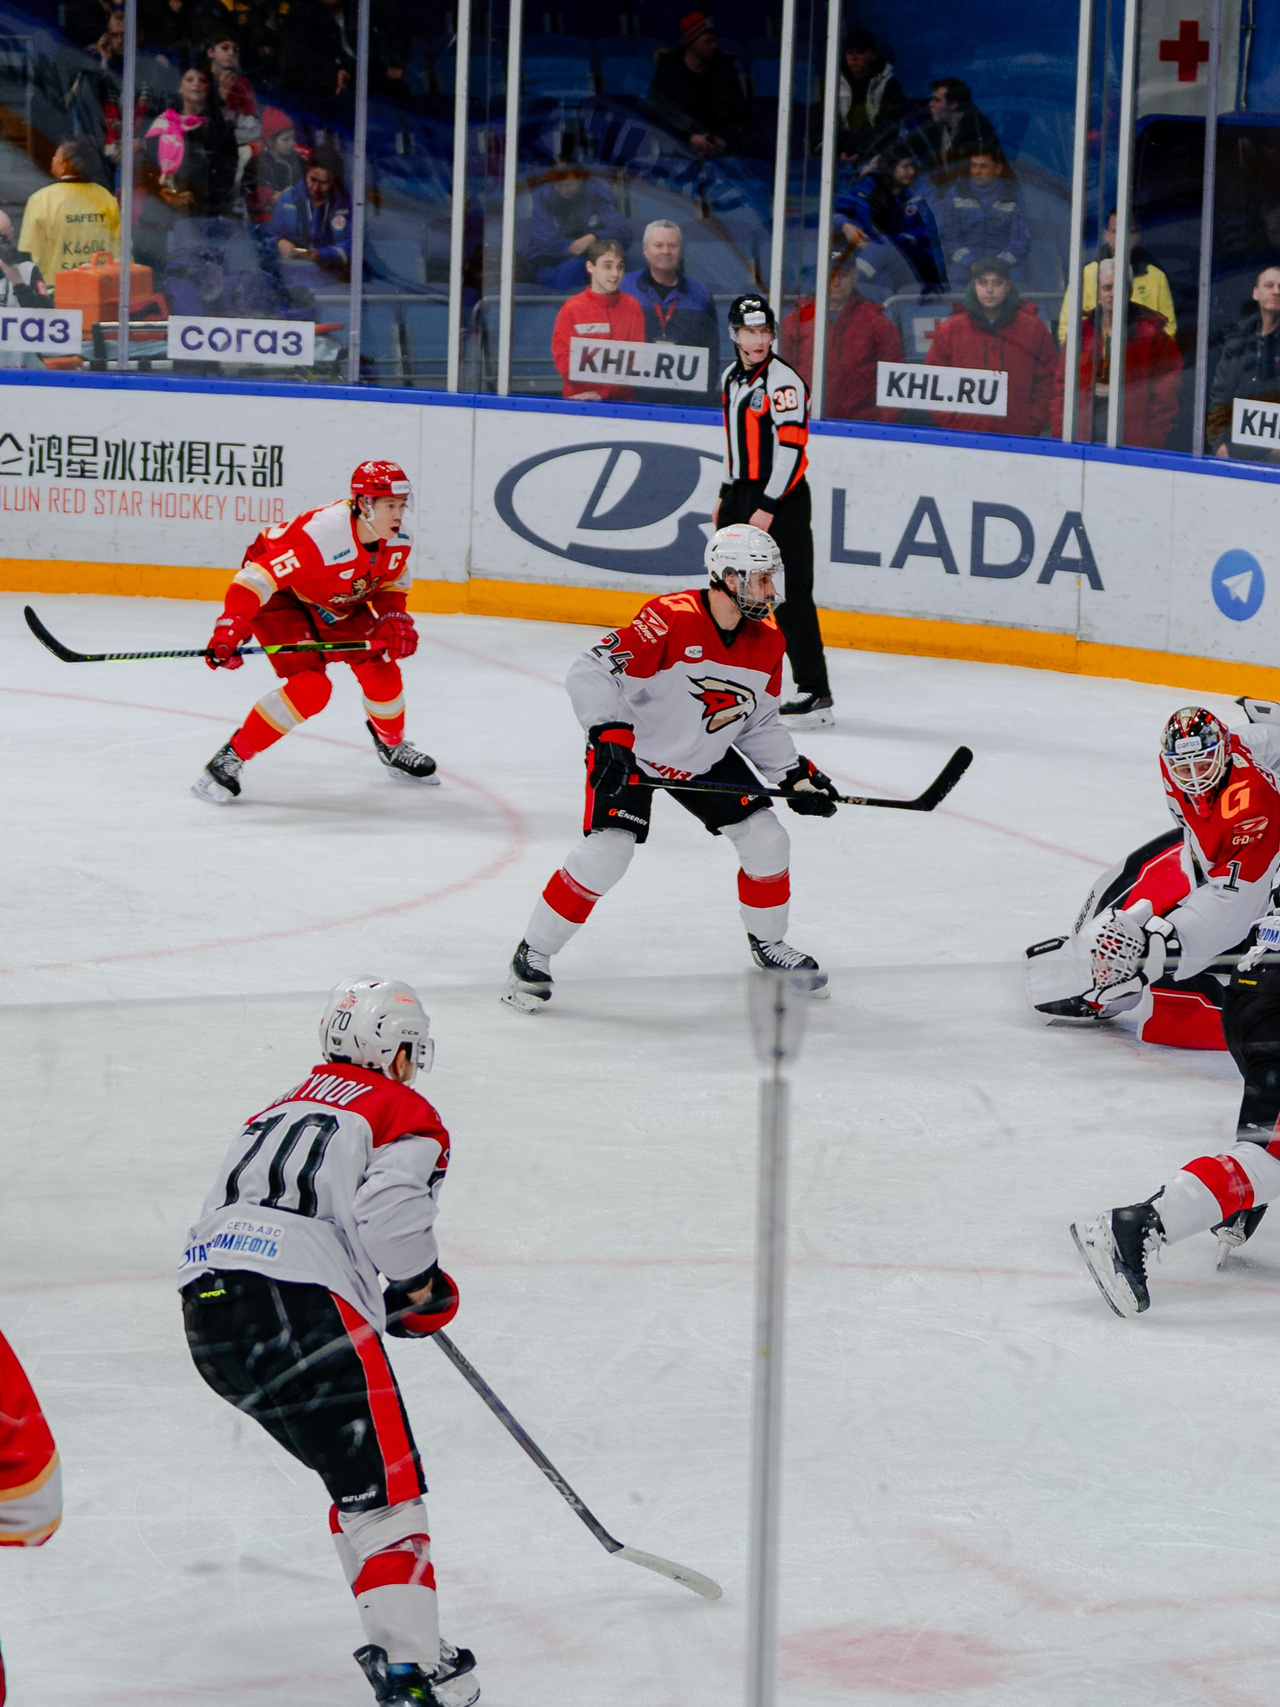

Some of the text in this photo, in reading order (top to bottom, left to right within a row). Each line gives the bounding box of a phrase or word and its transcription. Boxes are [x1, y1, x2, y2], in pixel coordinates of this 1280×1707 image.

[66, 212, 105, 224] SAFETY
[1, 317, 70, 344] газ
[180, 325, 303, 356] согаз
[579, 346, 700, 382] KHL.RU
[773, 386, 798, 412] 38
[886, 371, 1000, 407] KHL.RU
[50, 487, 85, 514] RED
[94, 489, 143, 517] STAR
[151, 492, 227, 521] HOCKEY
[235, 496, 284, 524] CLUB
[830, 488, 1105, 591] LADA
[270, 549, 301, 578] 15
[388, 552, 402, 570] C
[591, 632, 634, 676] 24
[1222, 861, 1241, 892] 1
[331, 1010, 351, 1031] 70
[277, 1073, 373, 1106] YNOV
[215, 1110, 342, 1220] 70
[226, 1220, 282, 1239] СЕТЬ АЗС
[191, 1233, 278, 1262] ГАОМНЕФТЬ
